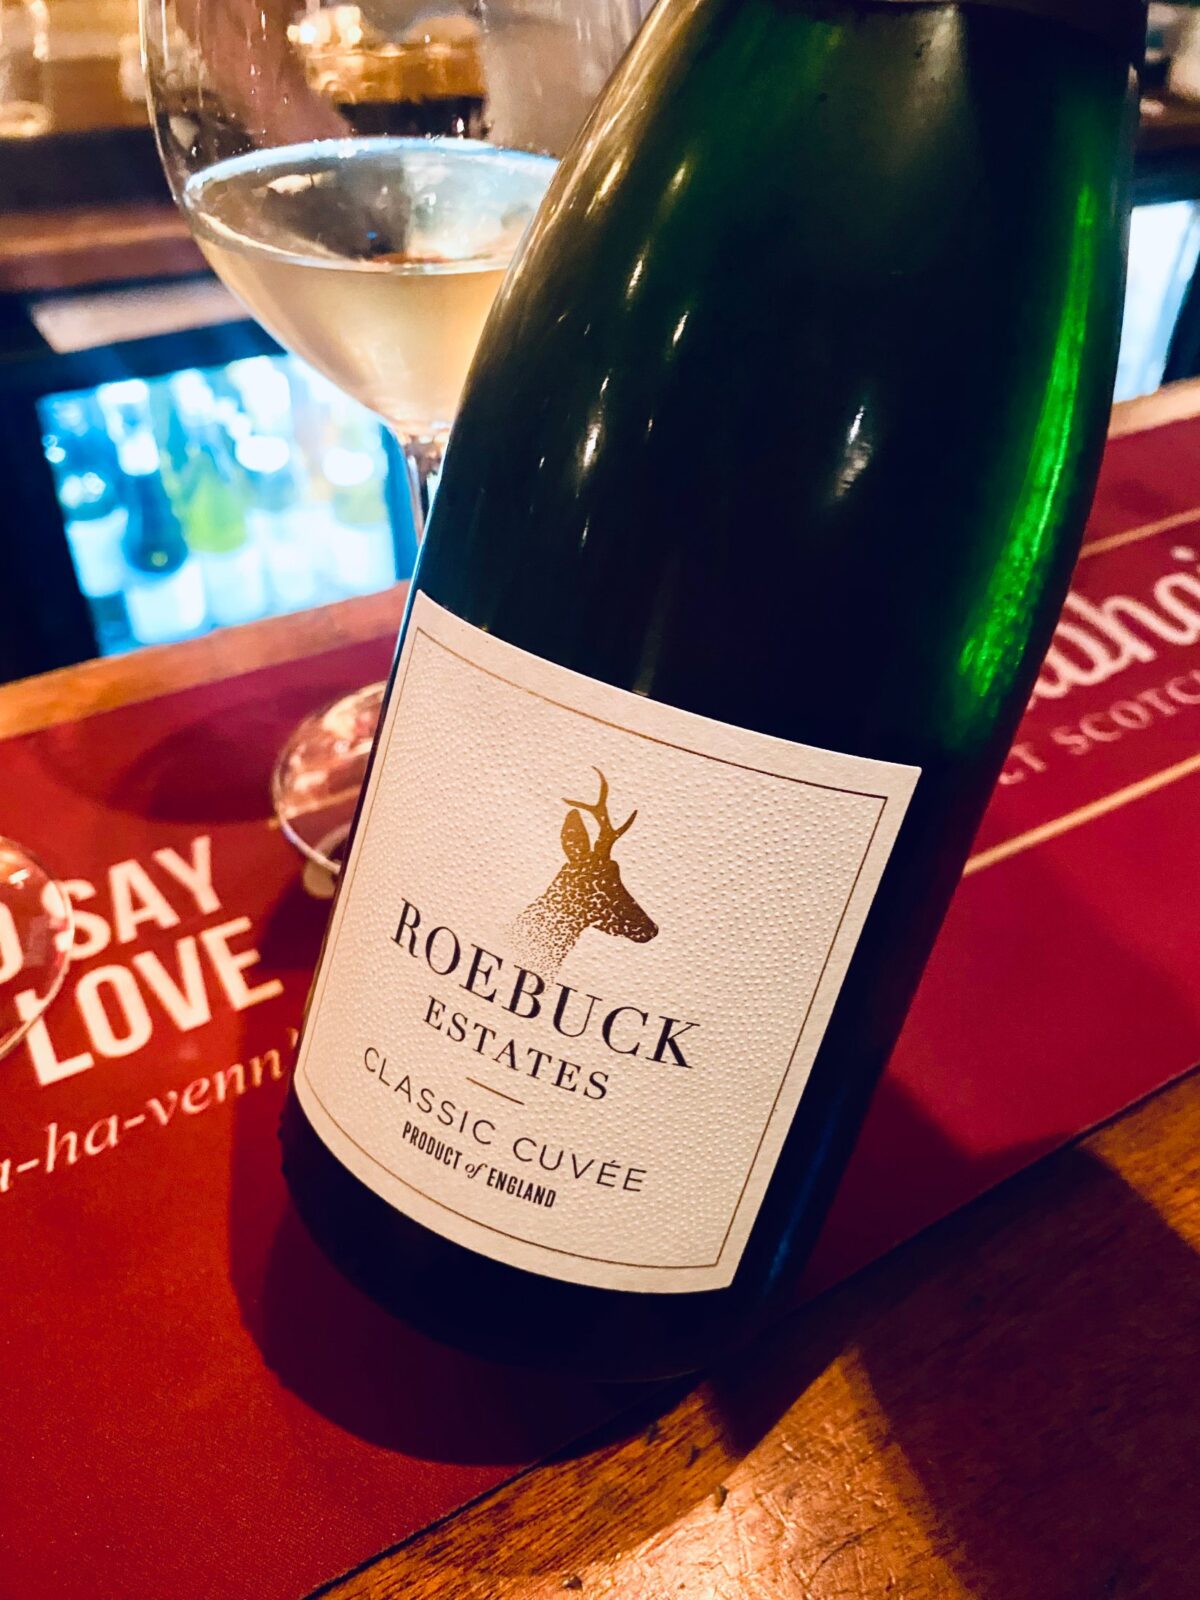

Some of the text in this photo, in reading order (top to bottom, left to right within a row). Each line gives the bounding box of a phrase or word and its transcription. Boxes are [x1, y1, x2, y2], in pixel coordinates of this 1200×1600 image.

[1051, 669, 1200, 755] SCOTC
[42, 834, 223, 962] SAY
[14, 916, 284, 1086] LOVE
[391, 898, 700, 1069] ROEBUCK
[423, 995, 609, 1100] ESTATES
[364, 1047, 648, 1192] CLASSIC CUVÉE
[402, 1121, 556, 1208] PRODUCT of ENGLAND
